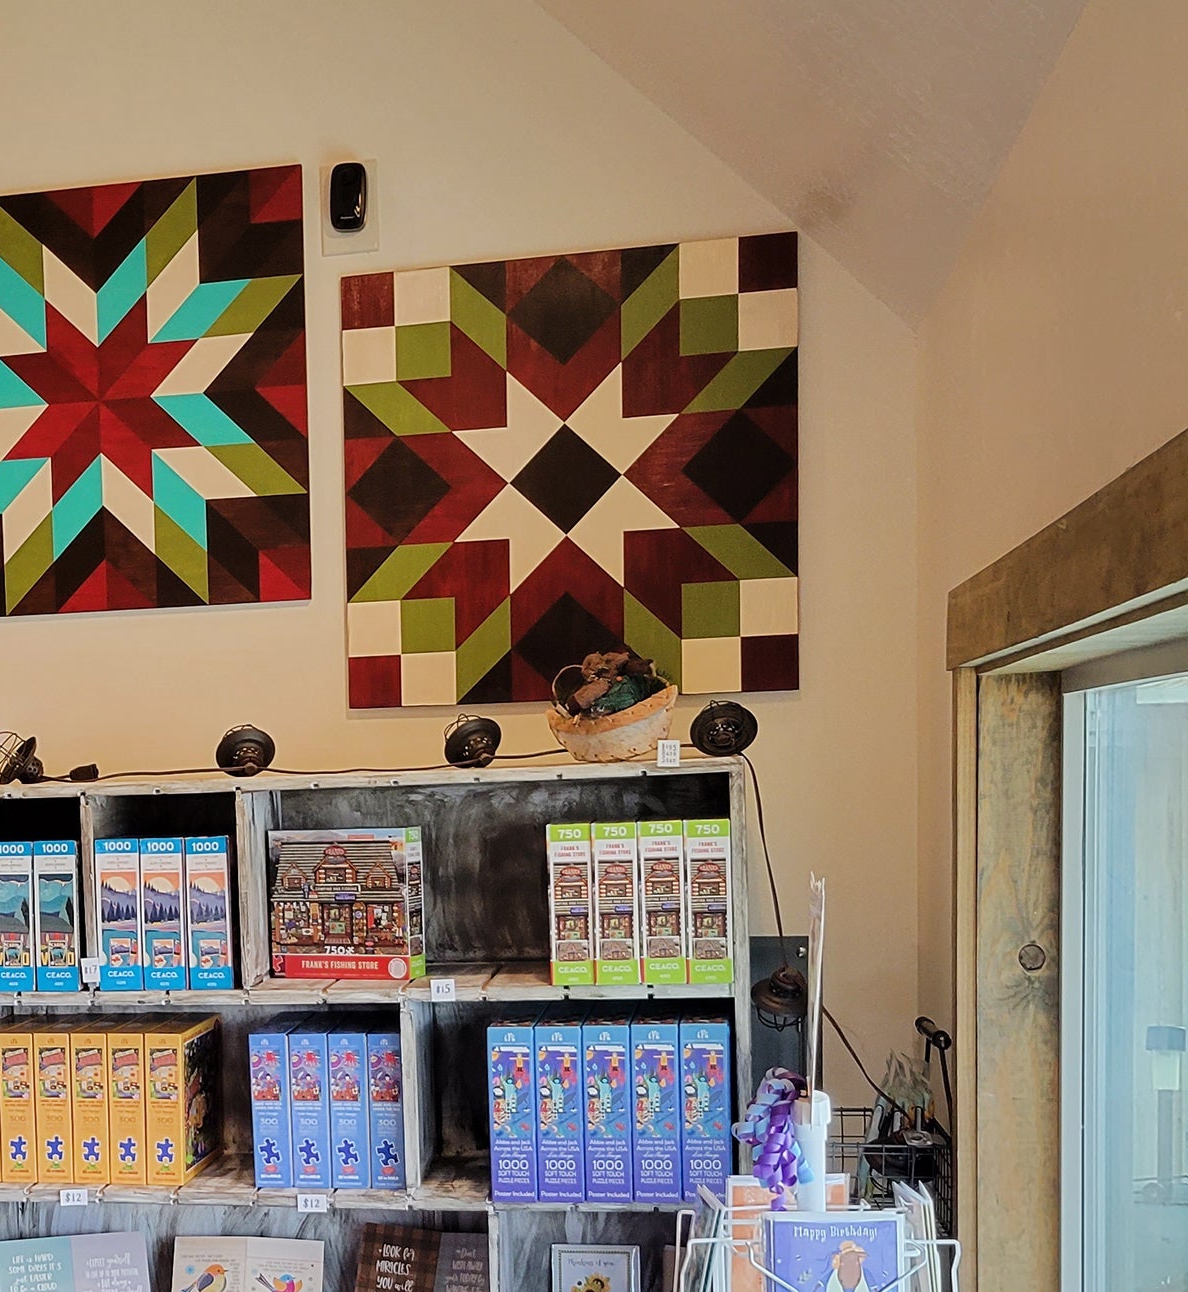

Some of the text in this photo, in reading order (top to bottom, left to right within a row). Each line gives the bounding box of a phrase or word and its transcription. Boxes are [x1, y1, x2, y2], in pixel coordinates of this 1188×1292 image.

[557, 829, 581, 838] 750
[603, 827, 627, 836] 750
[649, 824, 672, 833] 750
[695, 824, 720, 834] 750
[42, 844, 69, 852] 1000
[103, 841, 131, 850] 1000
[147, 841, 174, 851] 1000
[192, 842, 219, 851] 1000
[324, 946, 344, 955] 750
[301, 960, 379, 969] FRANK'S FISHING STORE
[498, 1160, 529, 1170] 1000
[545, 1160, 576, 1170] 1000
[592, 1160, 623, 1170] 1000
[641, 1160, 672, 1170] 1000
[689, 1160, 721, 1170] 1000
[65, 1193, 81, 1202] $12
[303, 1200, 320, 1209] $12
[793, 1225, 878, 1243] Happy Birthday!
[383, 1244, 400, 1258] LOOK
[376, 1260, 411, 1275] MIRACLES
[376, 1276, 414, 1292] YOU will
